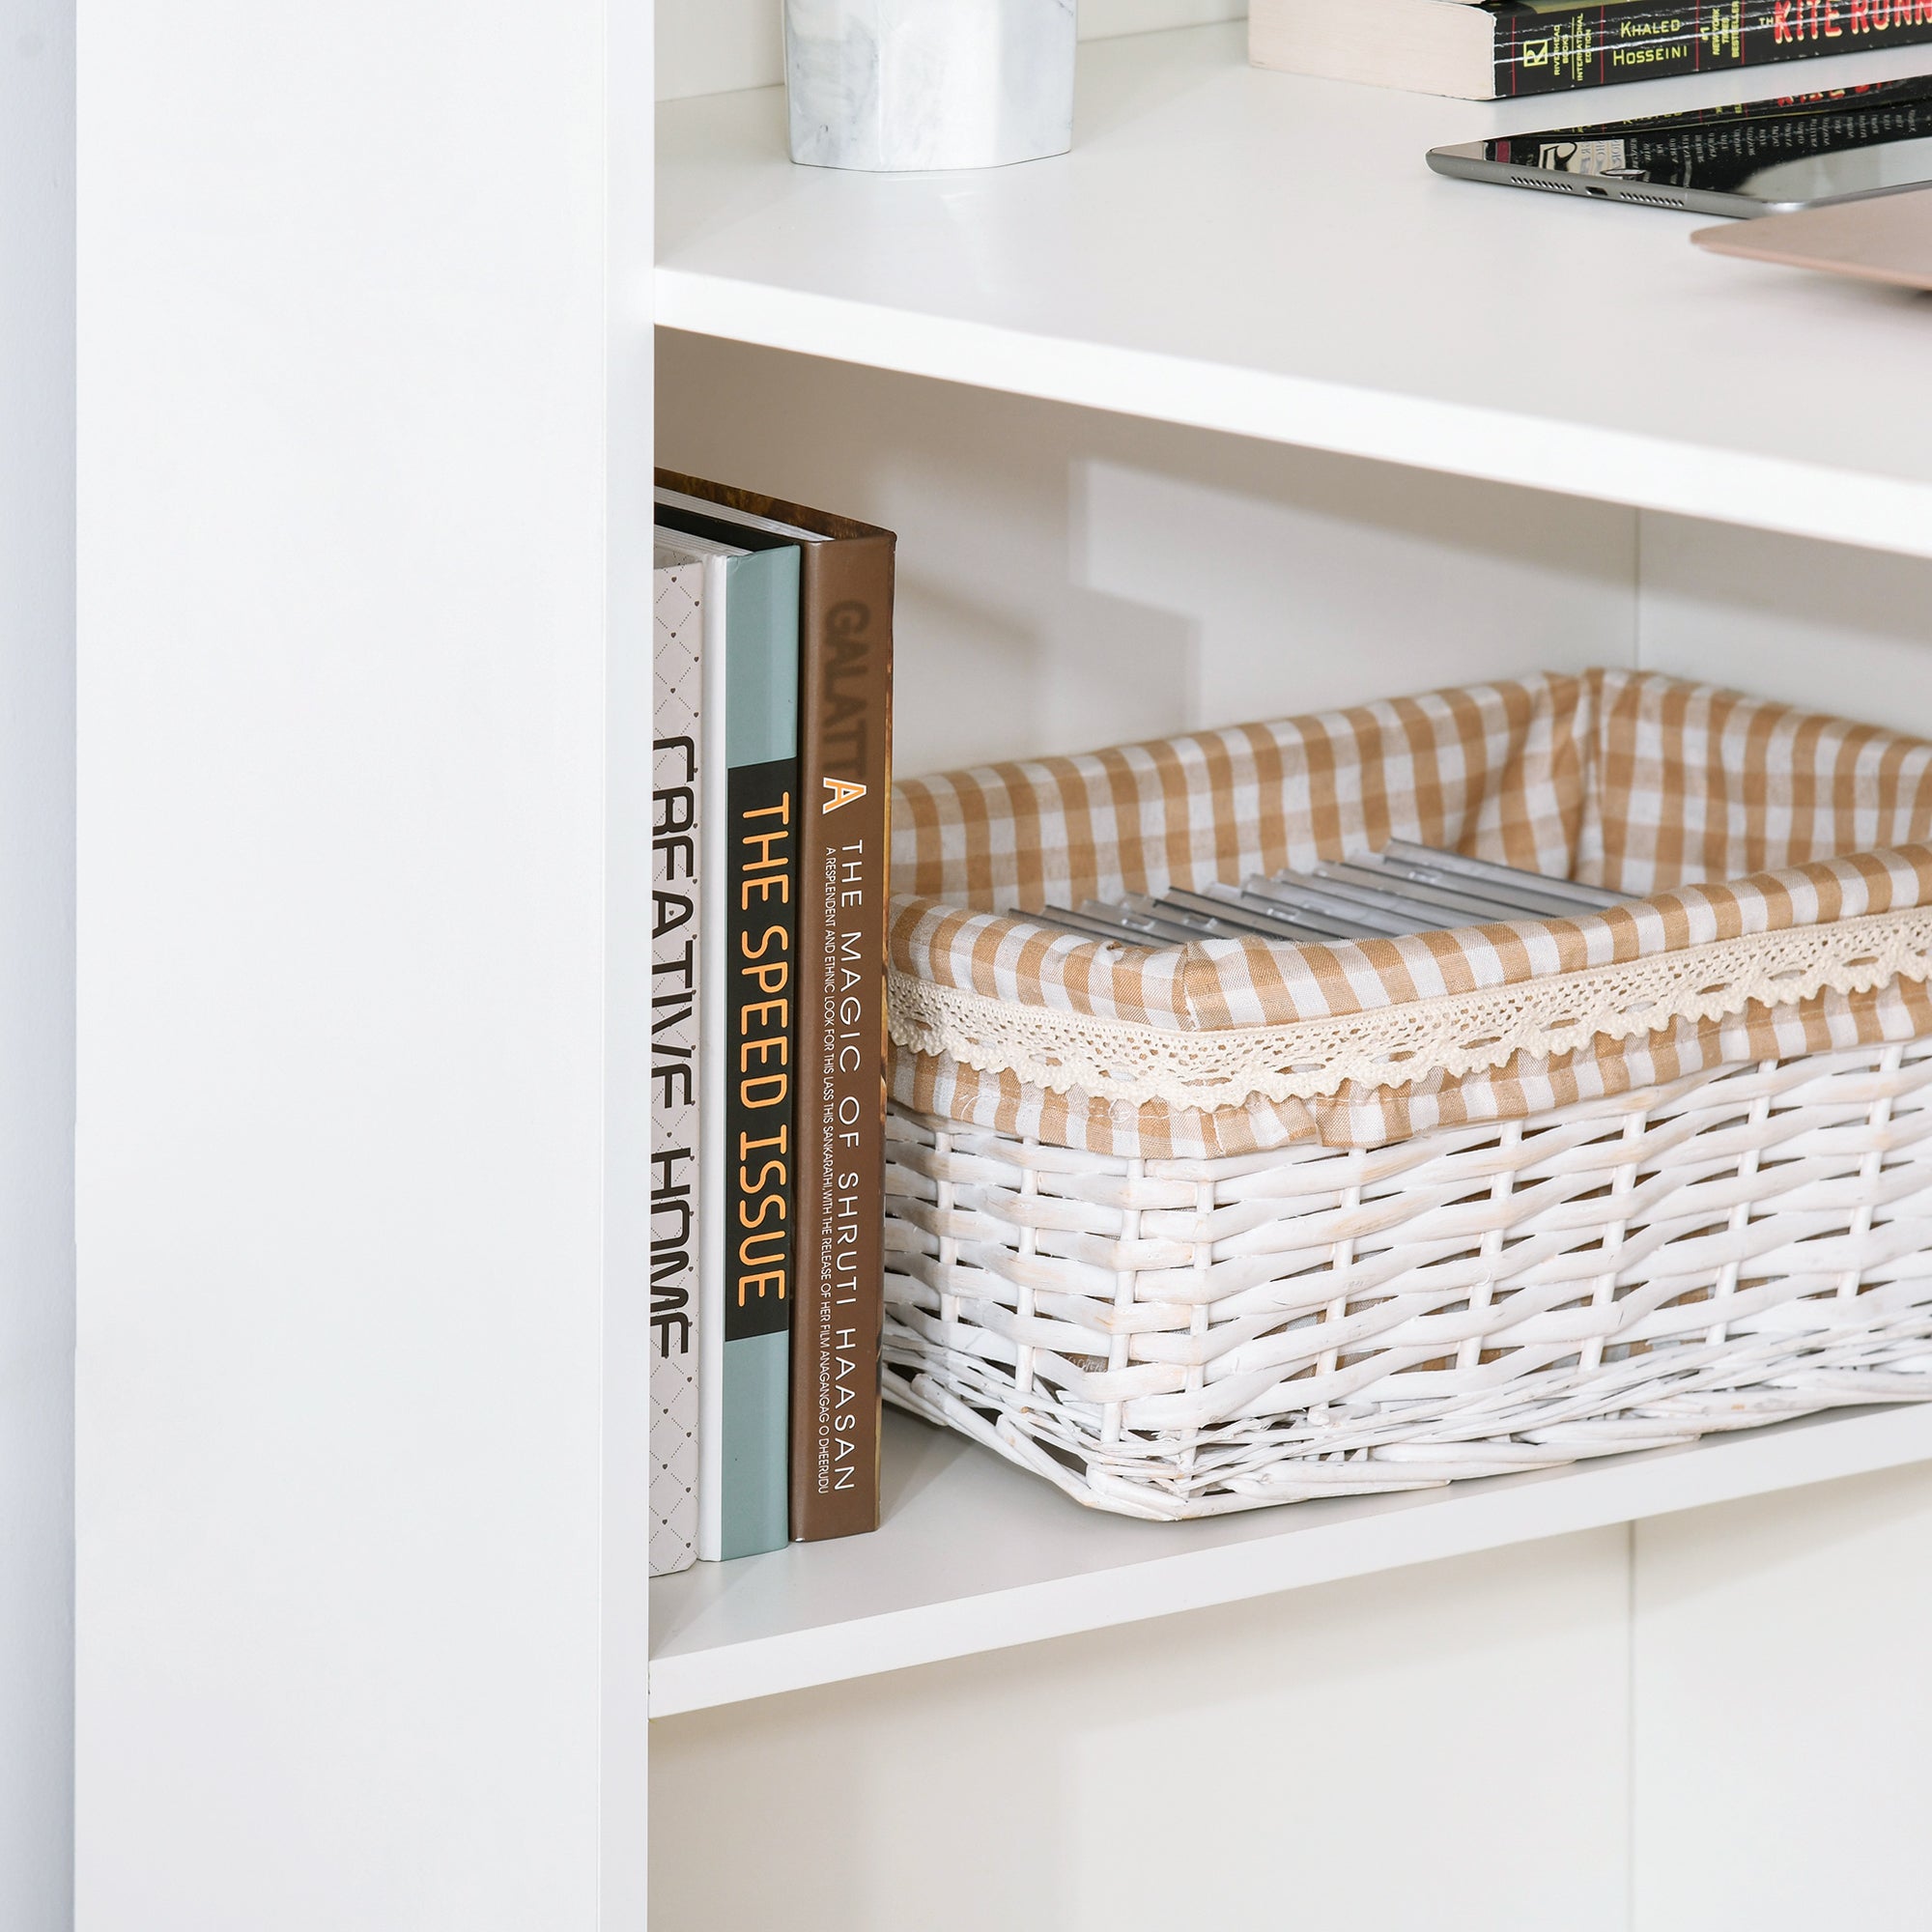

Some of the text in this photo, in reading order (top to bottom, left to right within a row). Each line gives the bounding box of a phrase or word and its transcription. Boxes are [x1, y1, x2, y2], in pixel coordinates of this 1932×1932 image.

[1621, 19, 1681, 38] KHALED
[1712, 8, 1720, 55] NEW YORK
[1721, 17, 1730, 44] TIMES
[1731, 1, 1740, 58] BESTSELLER
[1775, 0, 1842, 43] KITE
[1612, 45, 1688, 67] HOSSEINI
[826, 846, 837, 856] A
[825, 857, 837, 927] RESPLENDENT
[824, 929, 836, 953] AND
[824, 955, 836, 993] ETHNIC
[824, 995, 836, 1027] LOOK
[650, 735, 695, 1360] CREATIVE HOME
[739, 793, 788, 1306] THE SPEED ISSUE
[823, 1028, 836, 1051] FOR
[823, 1053, 835, 1074] THIS
[823, 1076, 835, 1101] LASS
[822, 1102, 835, 1124] THIS
[834, 838, 863, 1491] THE MAGIC OF SHRUTI HAASAN
[821, 1216, 833, 1236] THE
[820, 1237, 833, 1281] RELEASE
[820, 1283, 832, 1298] OF
[819, 1301, 831, 1322] HER
[819, 1323, 831, 1349] FILM
[818, 1350, 831, 1423] ANAGANGAG
[818, 1425, 830, 1436] O
[817, 1437, 830, 1494] DHEERUDU
